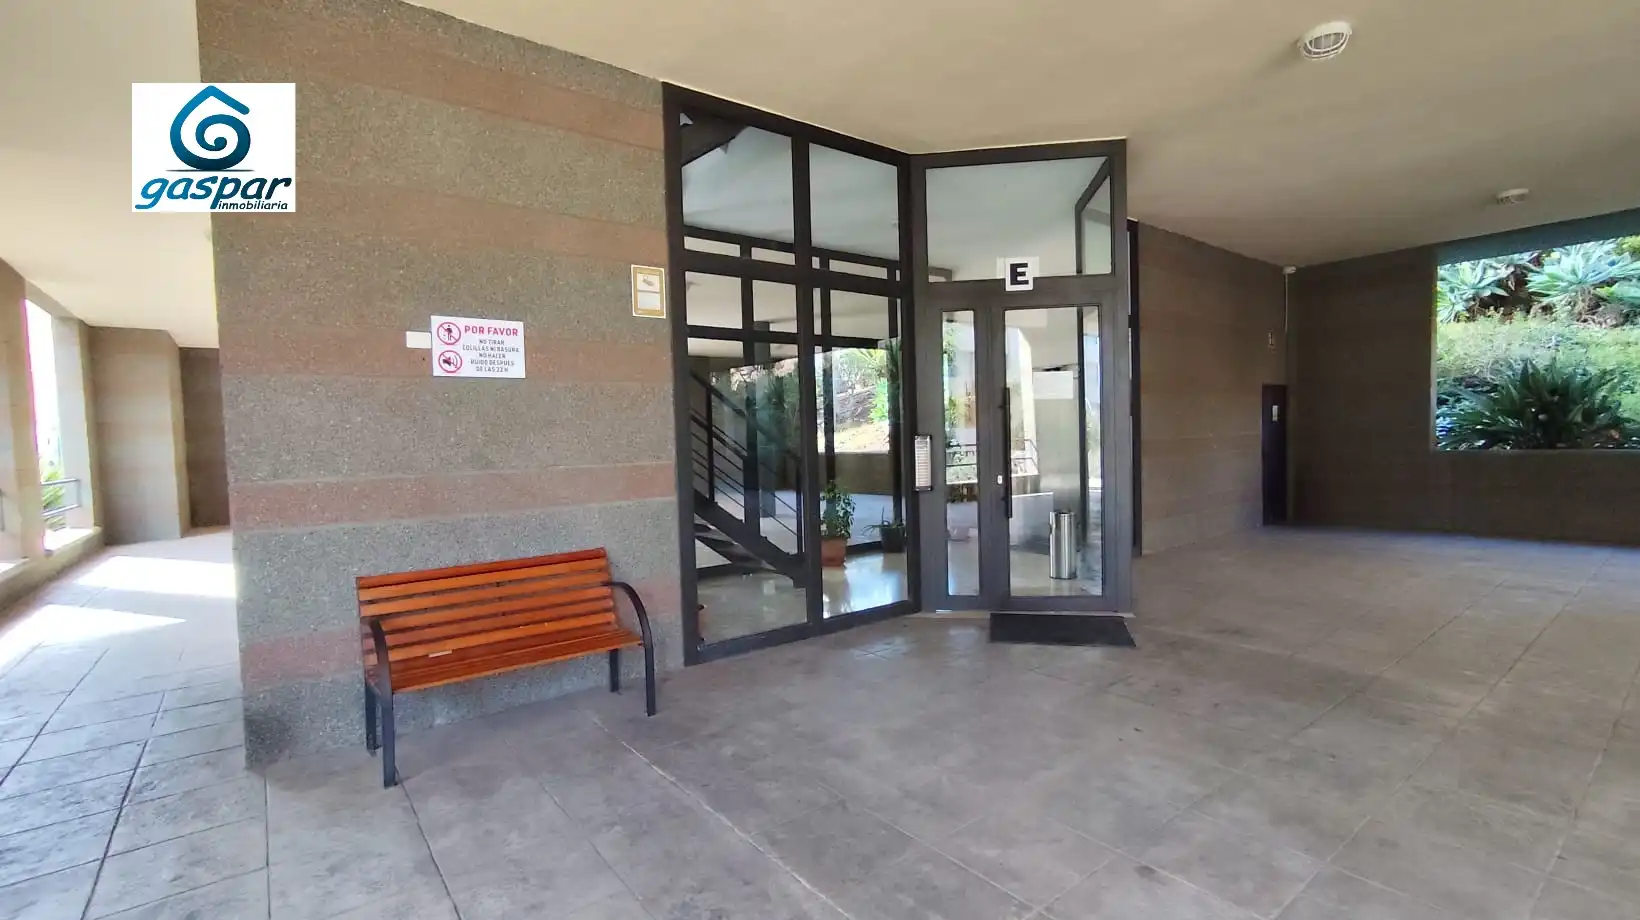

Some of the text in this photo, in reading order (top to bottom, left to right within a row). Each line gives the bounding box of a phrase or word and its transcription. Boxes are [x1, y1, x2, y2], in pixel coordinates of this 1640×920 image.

[1009, 262, 1030, 286] E
[464, 325, 519, 337] POR FAVOR
